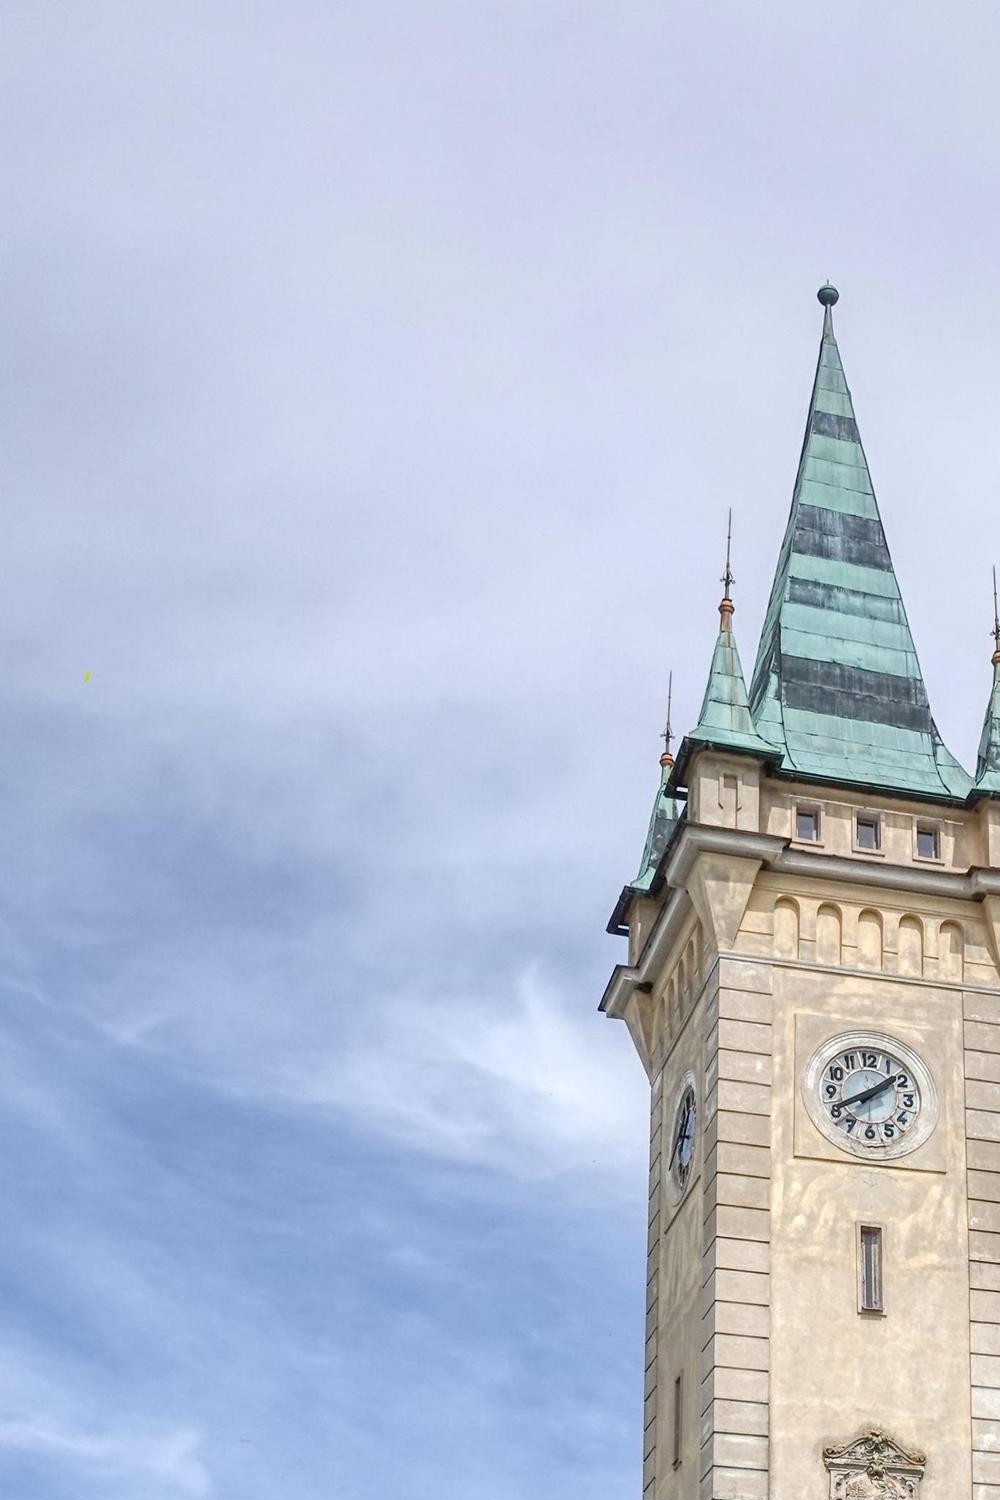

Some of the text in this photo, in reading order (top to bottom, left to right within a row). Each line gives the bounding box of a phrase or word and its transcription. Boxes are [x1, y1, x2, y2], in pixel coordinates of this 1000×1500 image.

[844, 1055, 854, 1069] 11
[862, 1053, 877, 1068] 12
[886, 1060, 890, 1074] 1
[830, 1066, 844, 1081] 10
[897, 1074, 908, 1088] 2
[826, 1085, 836, 1099] 9
[903, 1094, 914, 1108] 3
[830, 1104, 842, 1118] 8
[896, 1111, 908, 1124] 4
[846, 1119, 856, 1133] 7
[864, 1125, 876, 1139] 6
[884, 1124, 894, 1138] 5
